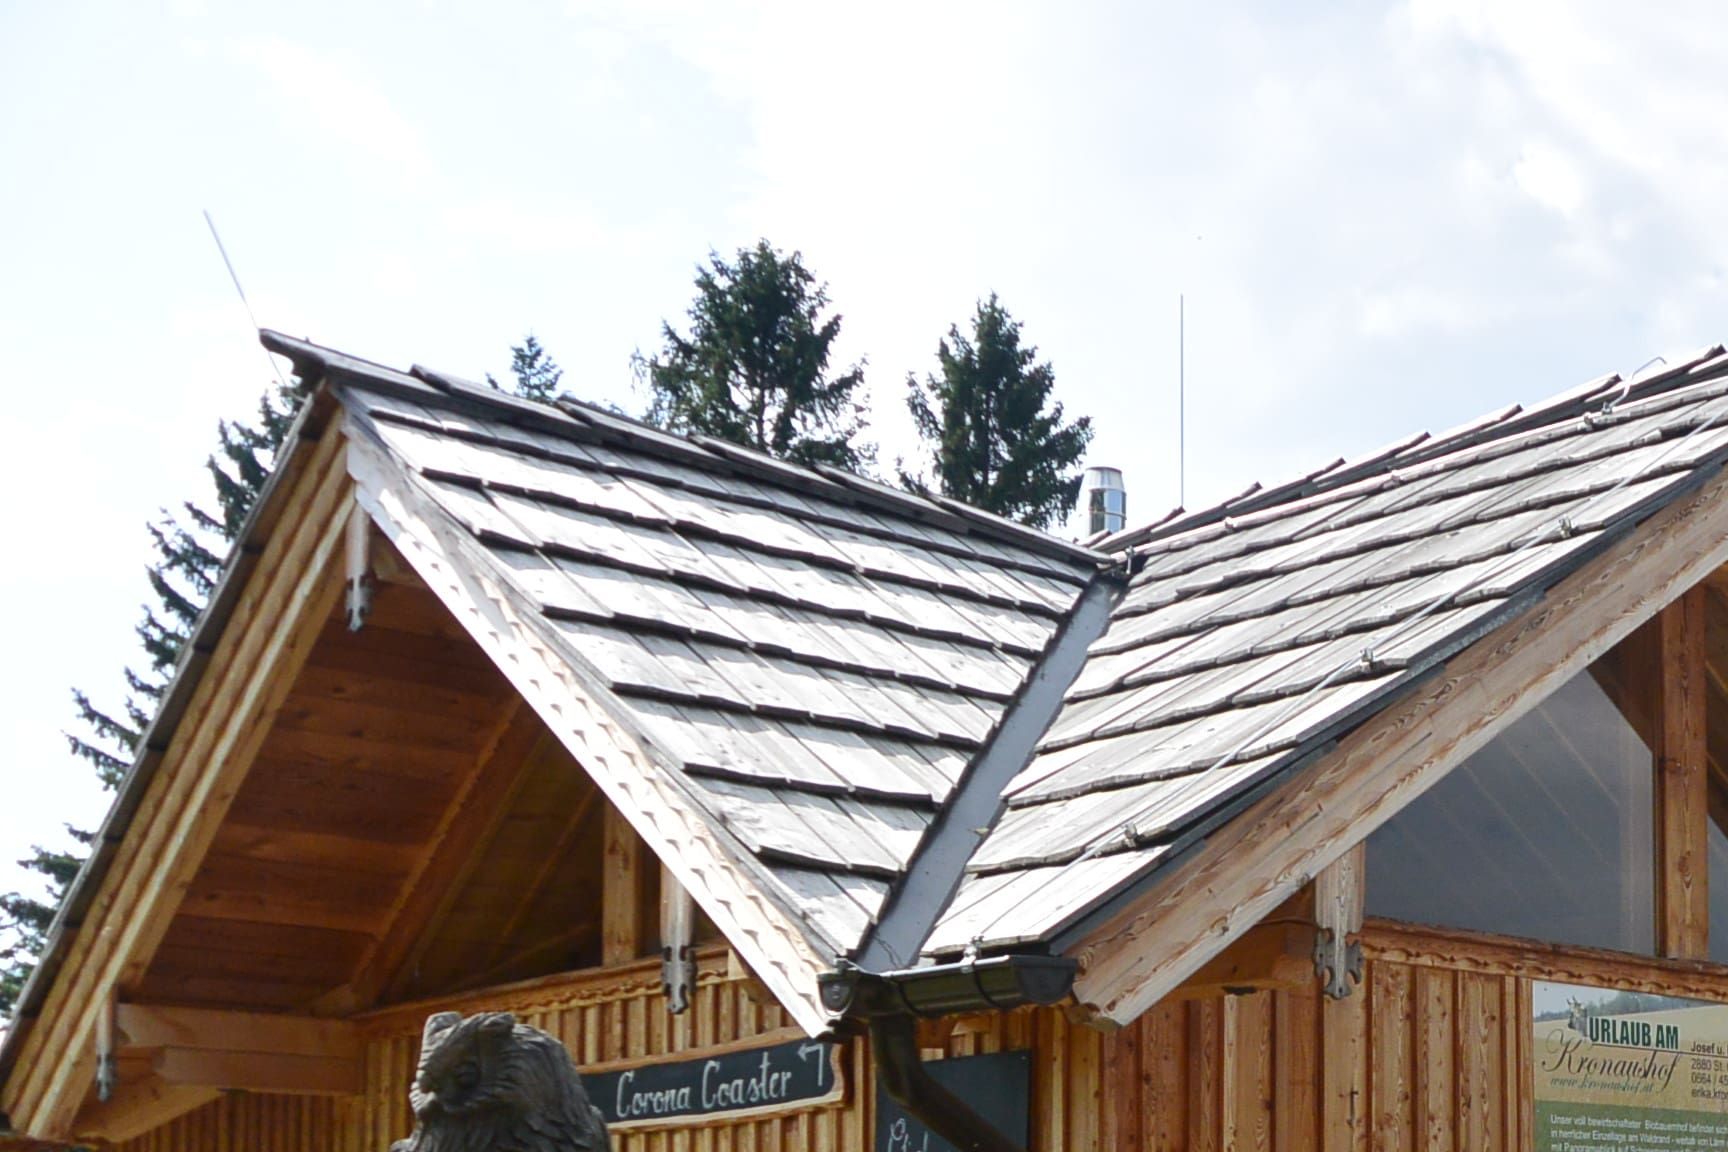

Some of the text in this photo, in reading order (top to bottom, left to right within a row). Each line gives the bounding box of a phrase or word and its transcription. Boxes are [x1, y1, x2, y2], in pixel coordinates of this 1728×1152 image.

[1590, 1016, 1680, 1050] URLAUB AM
[1691, 1041, 1716, 1053] Josef
[616, 1051, 792, 1118] Corona Coaster
[1541, 1028, 1681, 1093] Kronaushof
